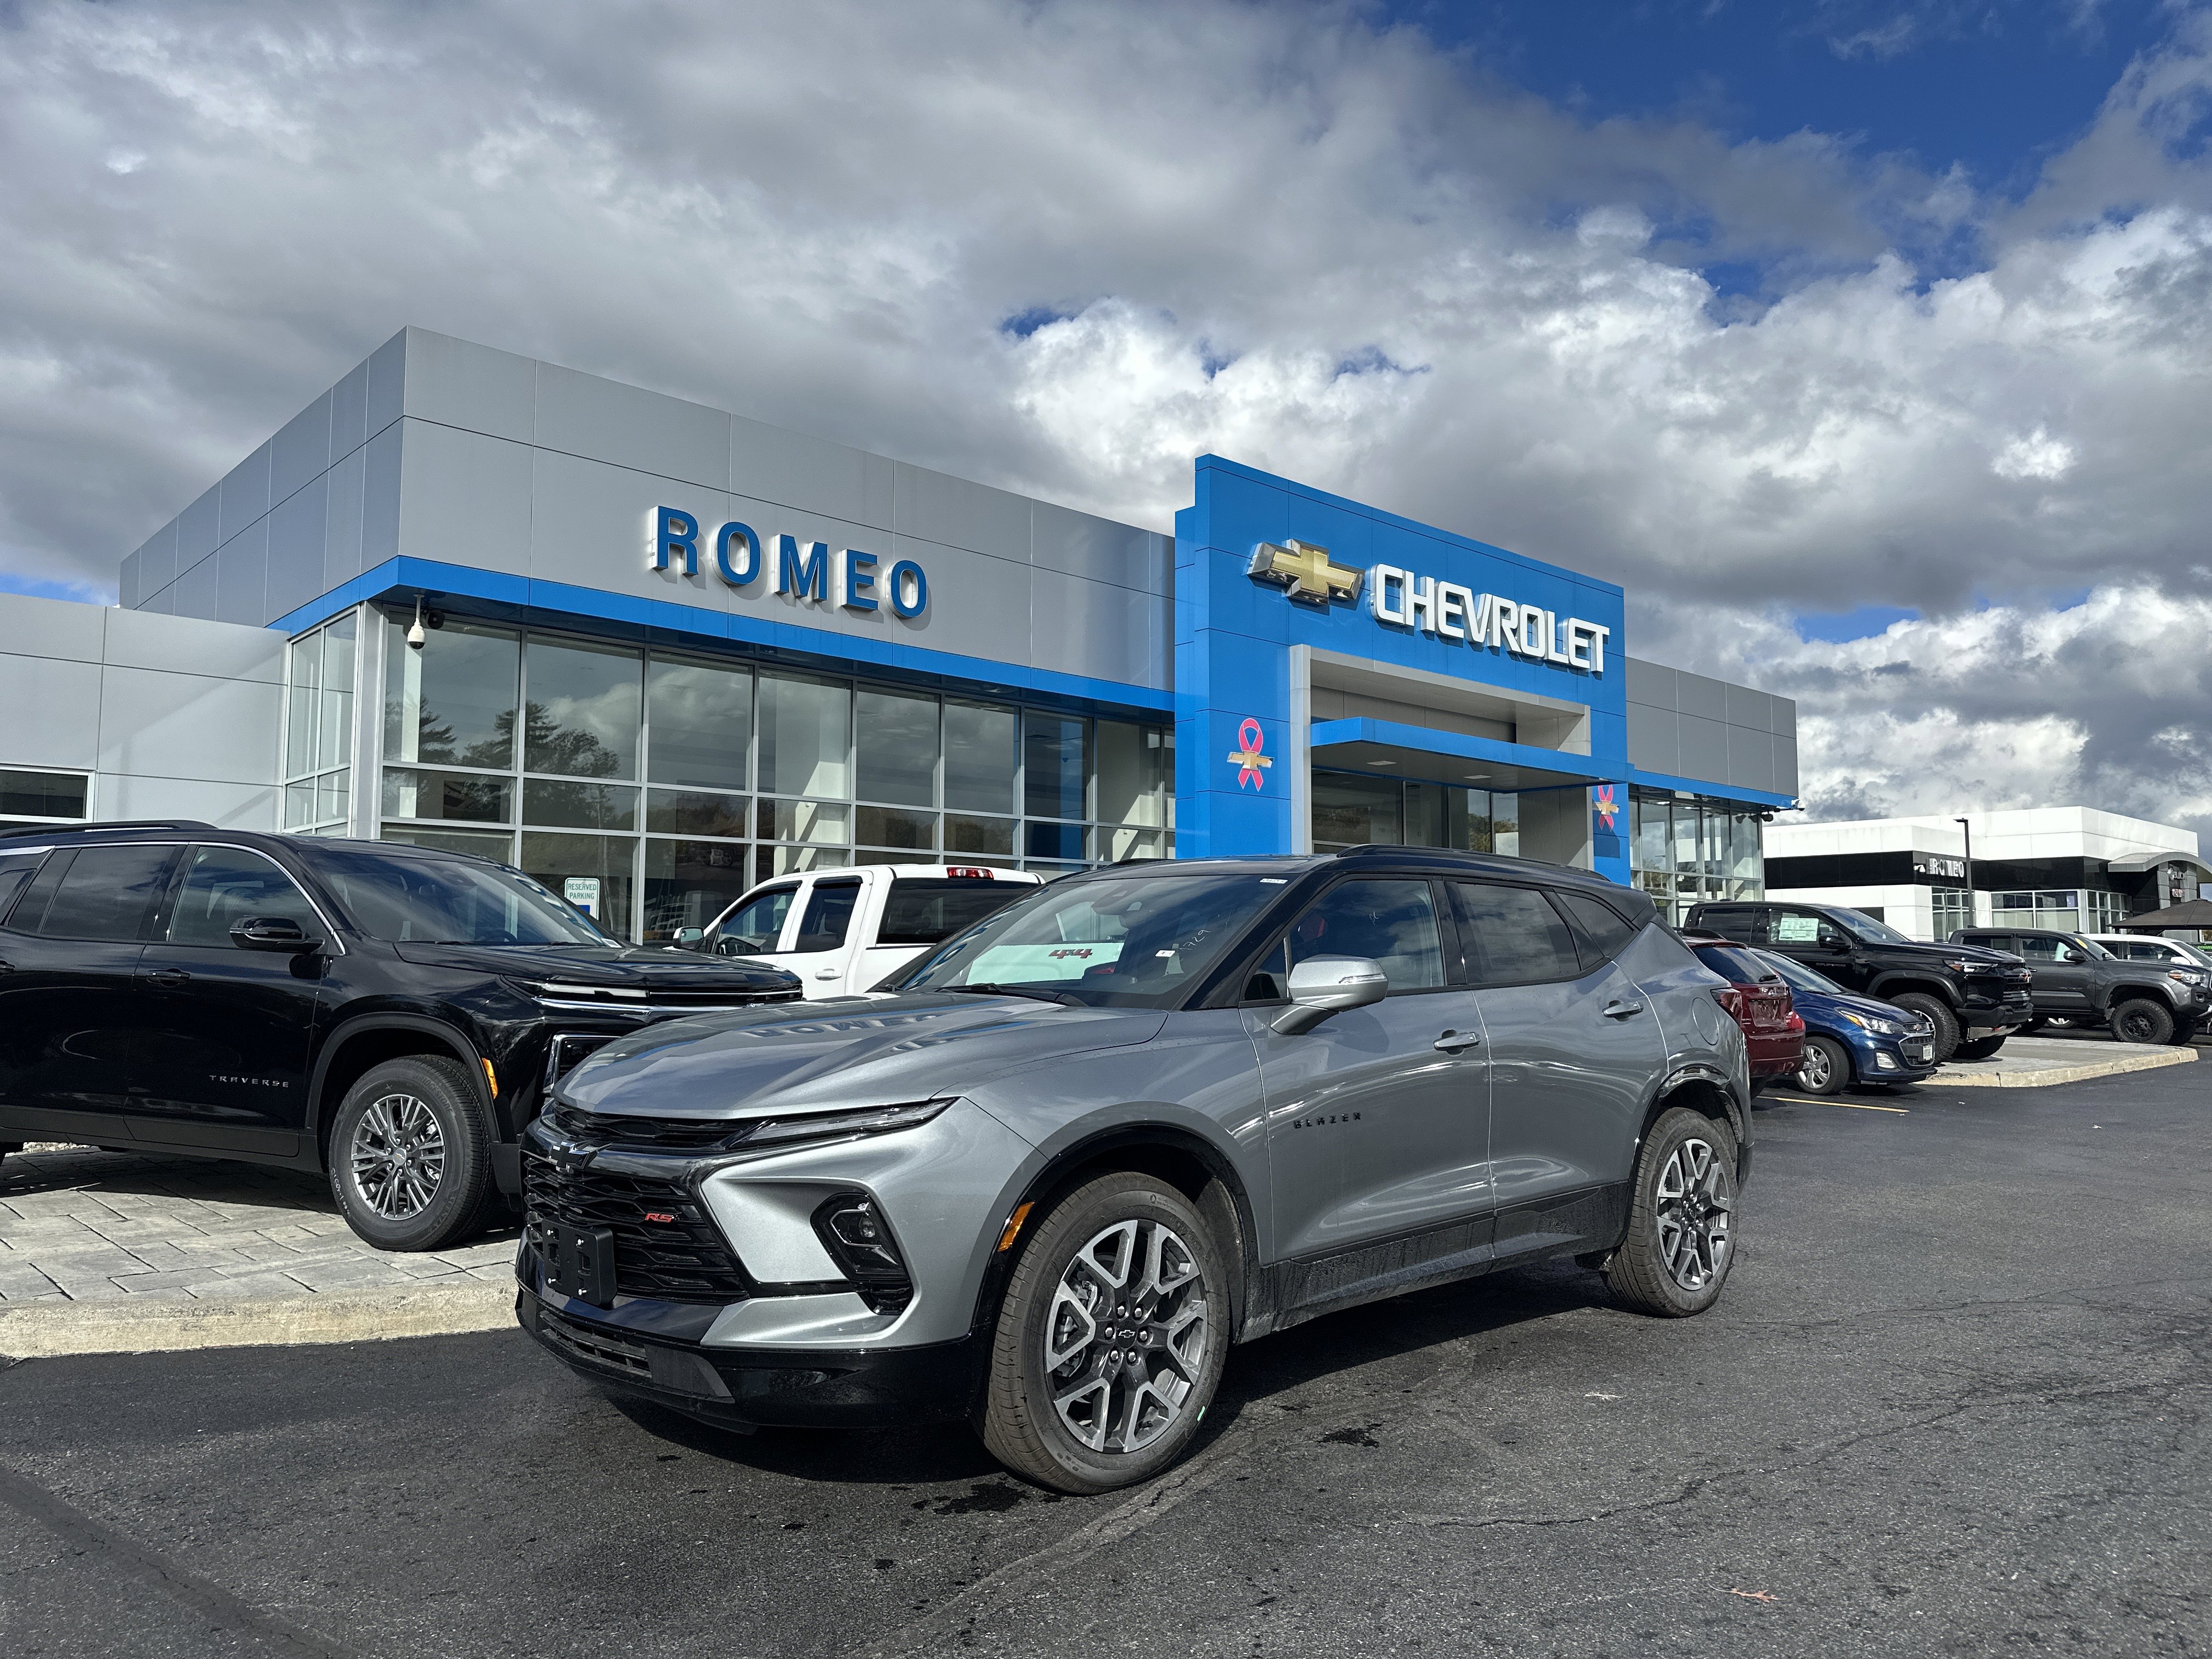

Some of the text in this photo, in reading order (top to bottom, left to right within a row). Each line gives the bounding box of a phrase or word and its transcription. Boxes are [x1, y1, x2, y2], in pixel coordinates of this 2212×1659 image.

[653, 505, 928, 618] ROMEO
[1370, 563, 1610, 672] CHEVROLET
[1929, 858, 1964, 878] ROMEO
[209, 1075, 289, 1088] TRAVERSE
[1294, 1111, 1361, 1129] BLAZER
[645, 1212, 673, 1223] RS
